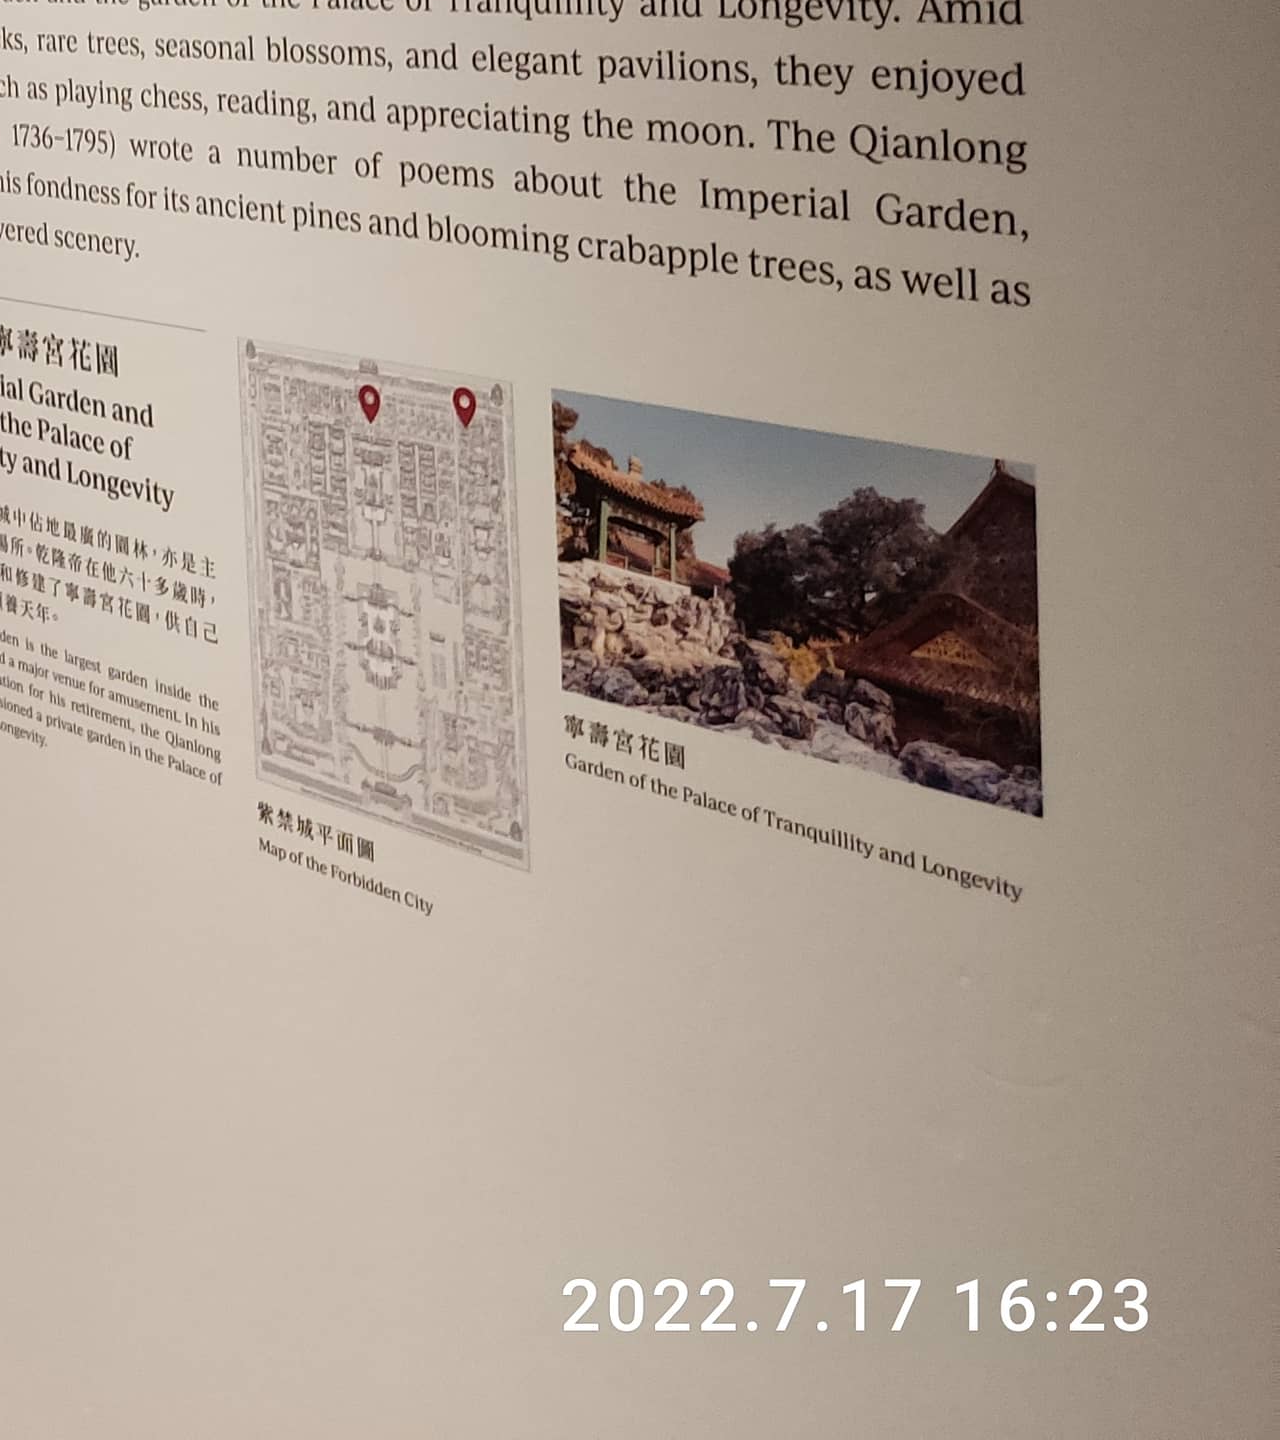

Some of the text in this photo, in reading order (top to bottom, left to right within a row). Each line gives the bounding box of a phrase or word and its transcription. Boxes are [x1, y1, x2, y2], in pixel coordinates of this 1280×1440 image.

[37, 33, 78, 54] rare
[87, 31, 145, 60] trees,
[155, 34, 254, 62] seasonal
[266, 35, 393, 73] blossoms,
[405, 41, 458, 71] and
[471, 43, 583, 81] elegant
[598, 49, 758, 89] pavilions,
[774, 53, 854, 96] they
[871, 58, 1026, 102] enjoyed
[27, 81, 48, 101] as
[55, 77, 133, 113] playing
[140, 82, 209, 116] chess,
[217, 89, 317, 125] reading,
[327, 95, 376, 123] and
[386, 102, 570, 143] appreciating
[582, 108, 634, 141] the
[647, 119, 755, 149] moon.
[767, 118, 836, 154] The
[849, 123, 1028, 175] Qianlong
[129, 137, 193, 163] wrote
[208, 144, 221, 165] a
[237, 145, 338, 175] number
[354, 151, 383, 179] of
[399, 160, 495, 190] poems
[514, 164, 603, 200] about
[623, 172, 676, 206] the
[700, 178, 850, 222] Imperial
[875, 192, 1029, 243] Garden,
[27, 171, 121, 206] fondness
[126, 181, 158, 210] for
[164, 186, 190, 213] its
[196, 193, 286, 225] ancient
[292, 201, 362, 233] pines
[368, 211, 419, 239] and
[426, 212, 570, 263] blooming
[577, 233, 739, 278] crabapple
[748, 248, 843, 292] trees,
[854, 265, 892, 292] as
[901, 266, 979, 302] well
[990, 279, 1031, 308] as
[54, 229, 140, 263] scenery.
[0, 410, 32, 438] the
[37, 418, 105, 455] Palace
[109, 435, 134, 461] of
[28, 381, 106, 419] Garden
[111, 402, 154, 429] and
[22, 455, 61, 481] and
[67, 460, 175, 513] Longevity
[17, 660, 50, 680] major
[52, 671, 86, 692] venue
[88, 680, 106, 699] for
[107, 689, 182, 724] amusement.
[184, 711, 198, 729] In
[201, 716, 221, 737] his
[25, 636, 35, 653] is
[40, 642, 59, 660] the
[64, 648, 102, 674] largest
[107, 666, 148, 690] garden
[155, 678, 192, 703] inside
[198, 693, 219, 712] the
[565, 752, 1024, 903] Garden of the Palace of Tranquillity and Longevity
[258, 836, 434, 917] Map of the Forbidden City
